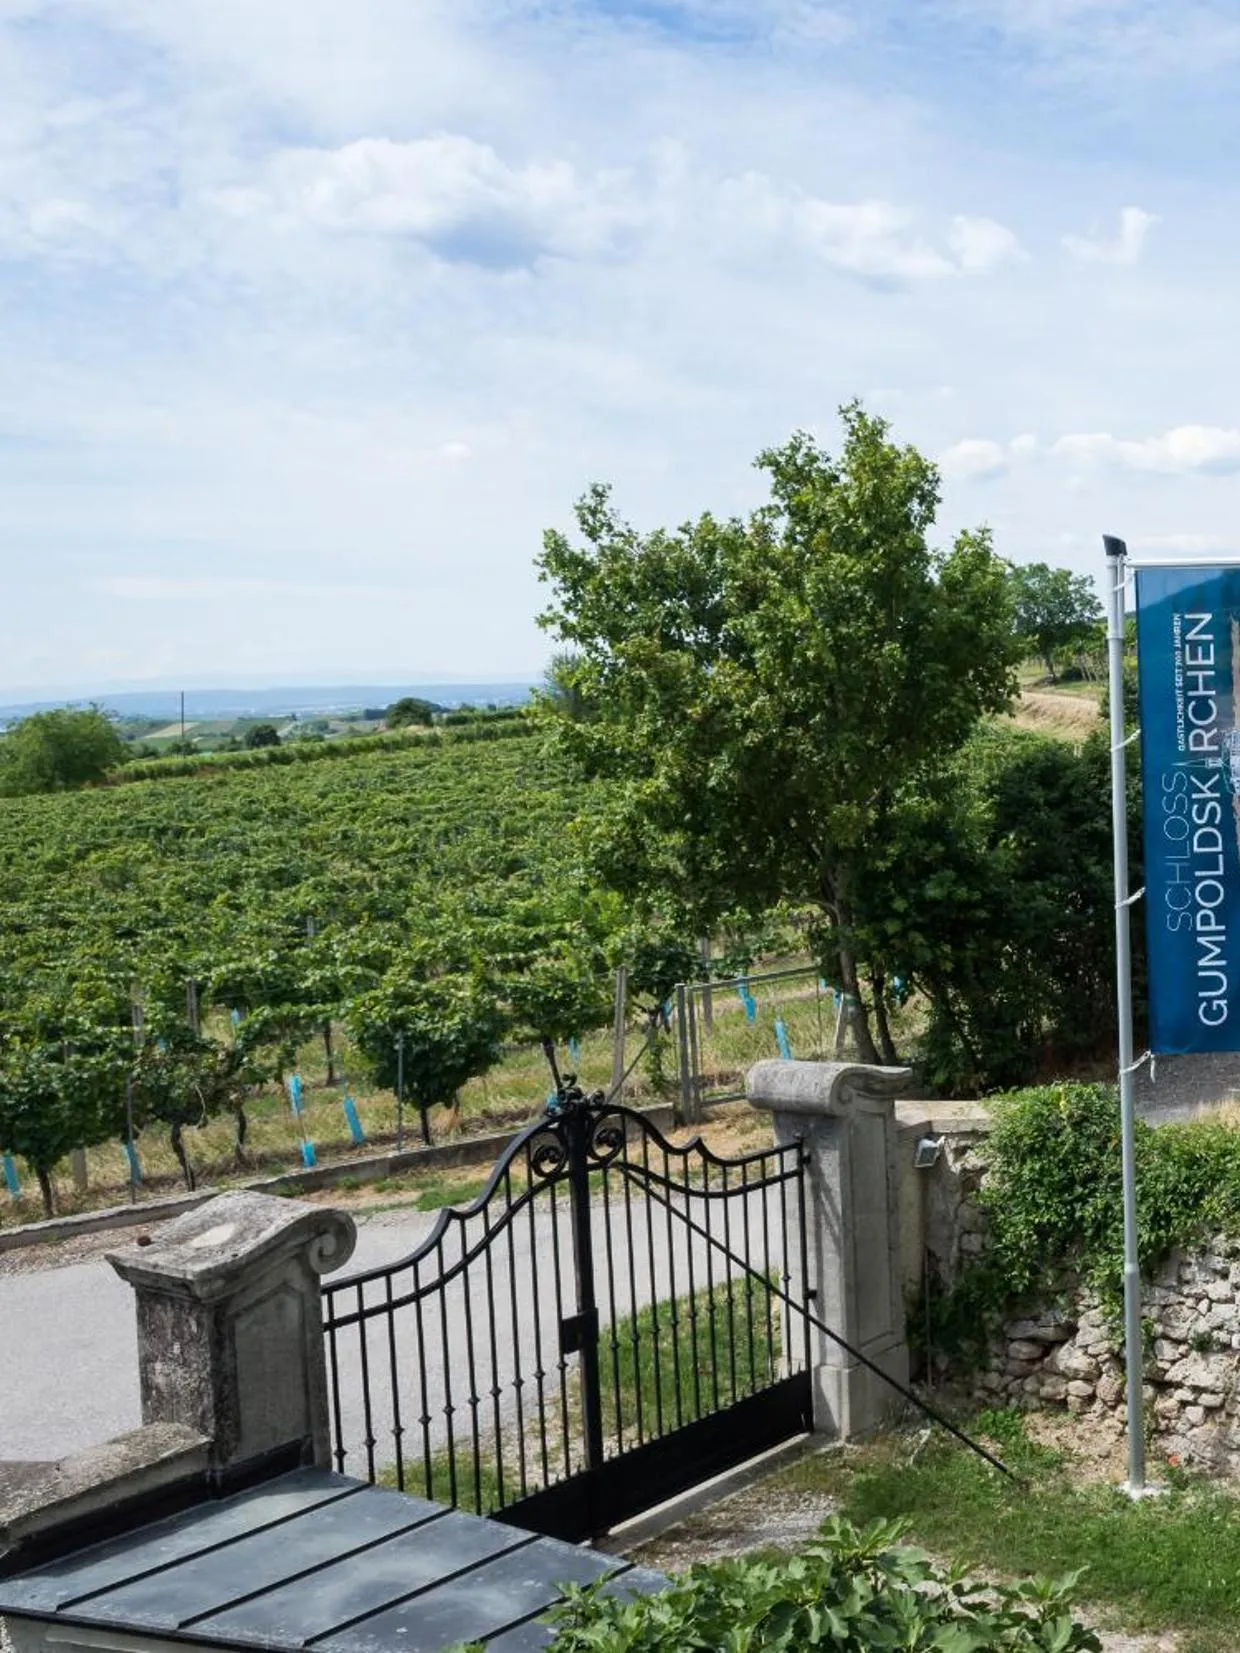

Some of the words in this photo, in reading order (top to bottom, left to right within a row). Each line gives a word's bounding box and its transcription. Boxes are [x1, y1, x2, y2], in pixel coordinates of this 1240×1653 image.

[1172, 613, 1183, 647] JAHREN
[1174, 667, 1184, 686] SEIT
[1161, 771, 1193, 932] SCHLOSS
